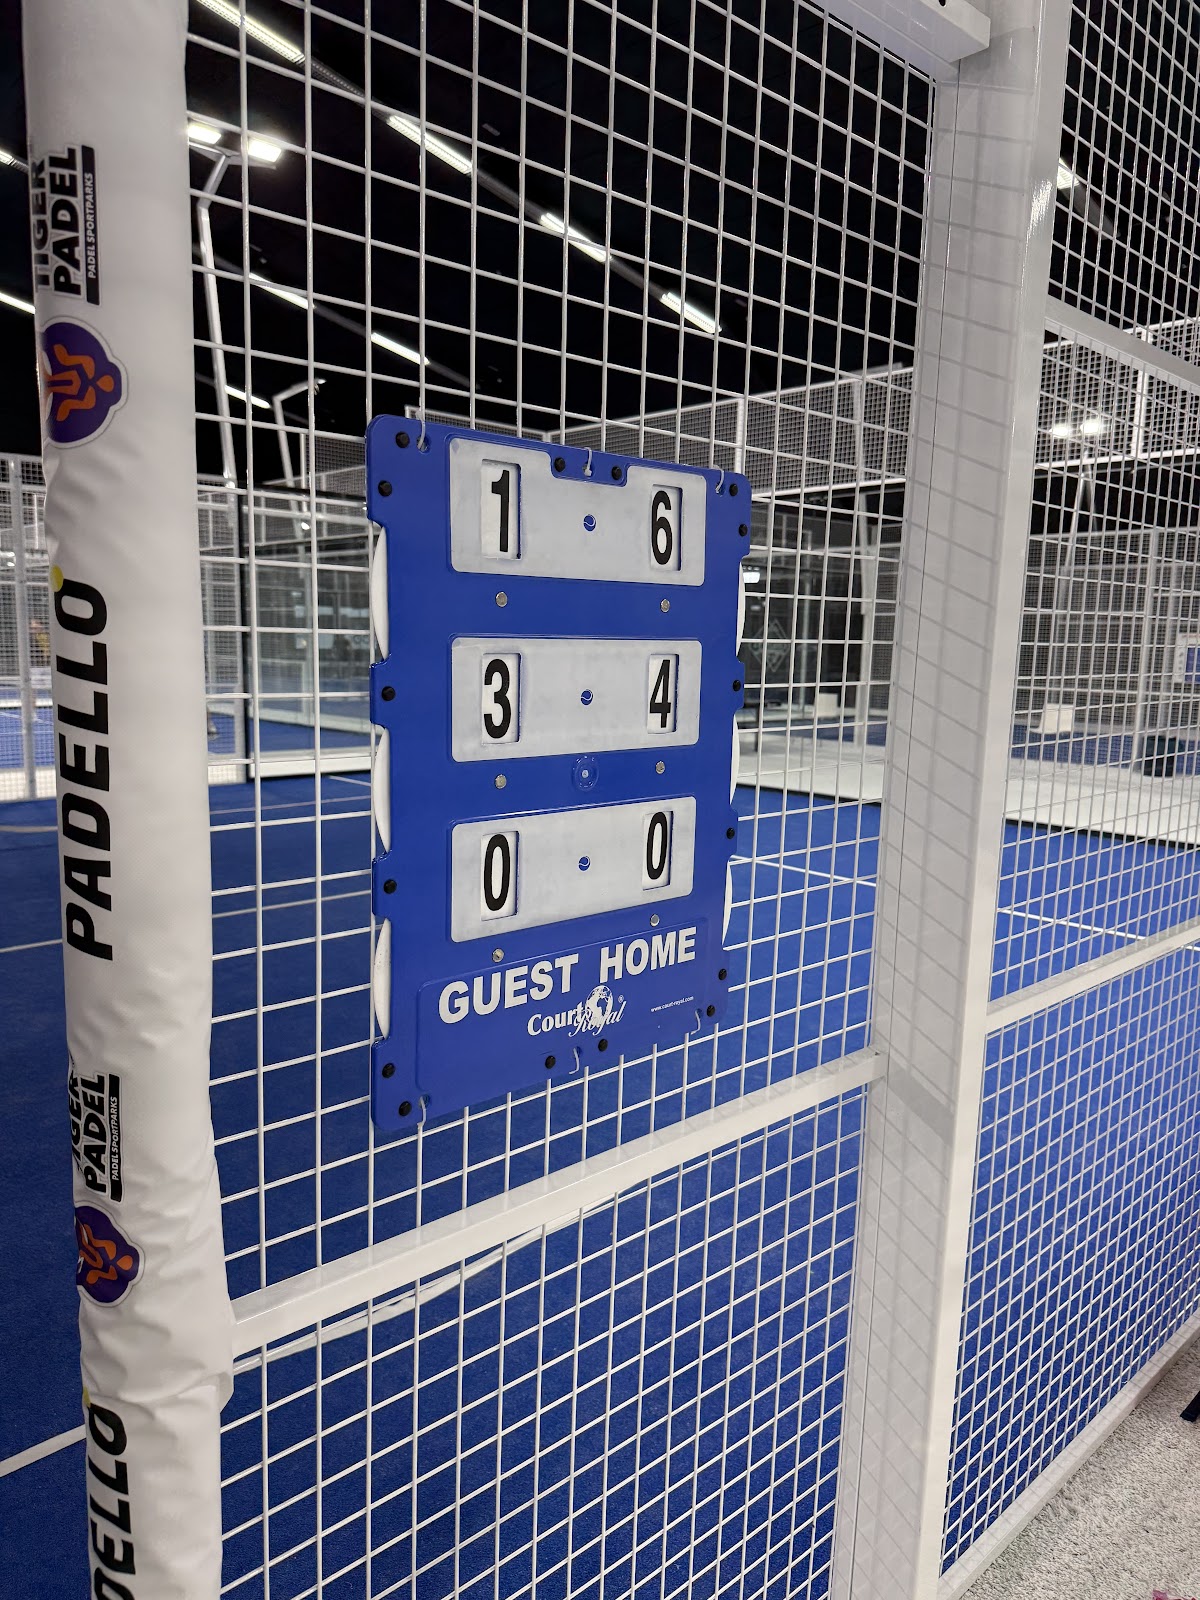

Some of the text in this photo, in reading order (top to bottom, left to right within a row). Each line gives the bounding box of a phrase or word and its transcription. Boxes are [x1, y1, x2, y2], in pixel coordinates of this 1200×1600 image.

[31, 158, 51, 290] TIGER
[49, 147, 83, 295] PADEL
[84, 172, 97, 279] PADEL SPORTPARKS
[491, 469, 674, 566] 1 6
[484, 659, 672, 739] 3 4
[54, 578, 113, 961] PADELLO
[484, 811, 668, 912] 0 0
[438, 926, 697, 1024] GUEST HOME
[527, 1002, 584, 1036] Court
[81, 1074, 107, 1193] PADEL
[110, 1096, 119, 1180] PADEL SPORTPARKS
